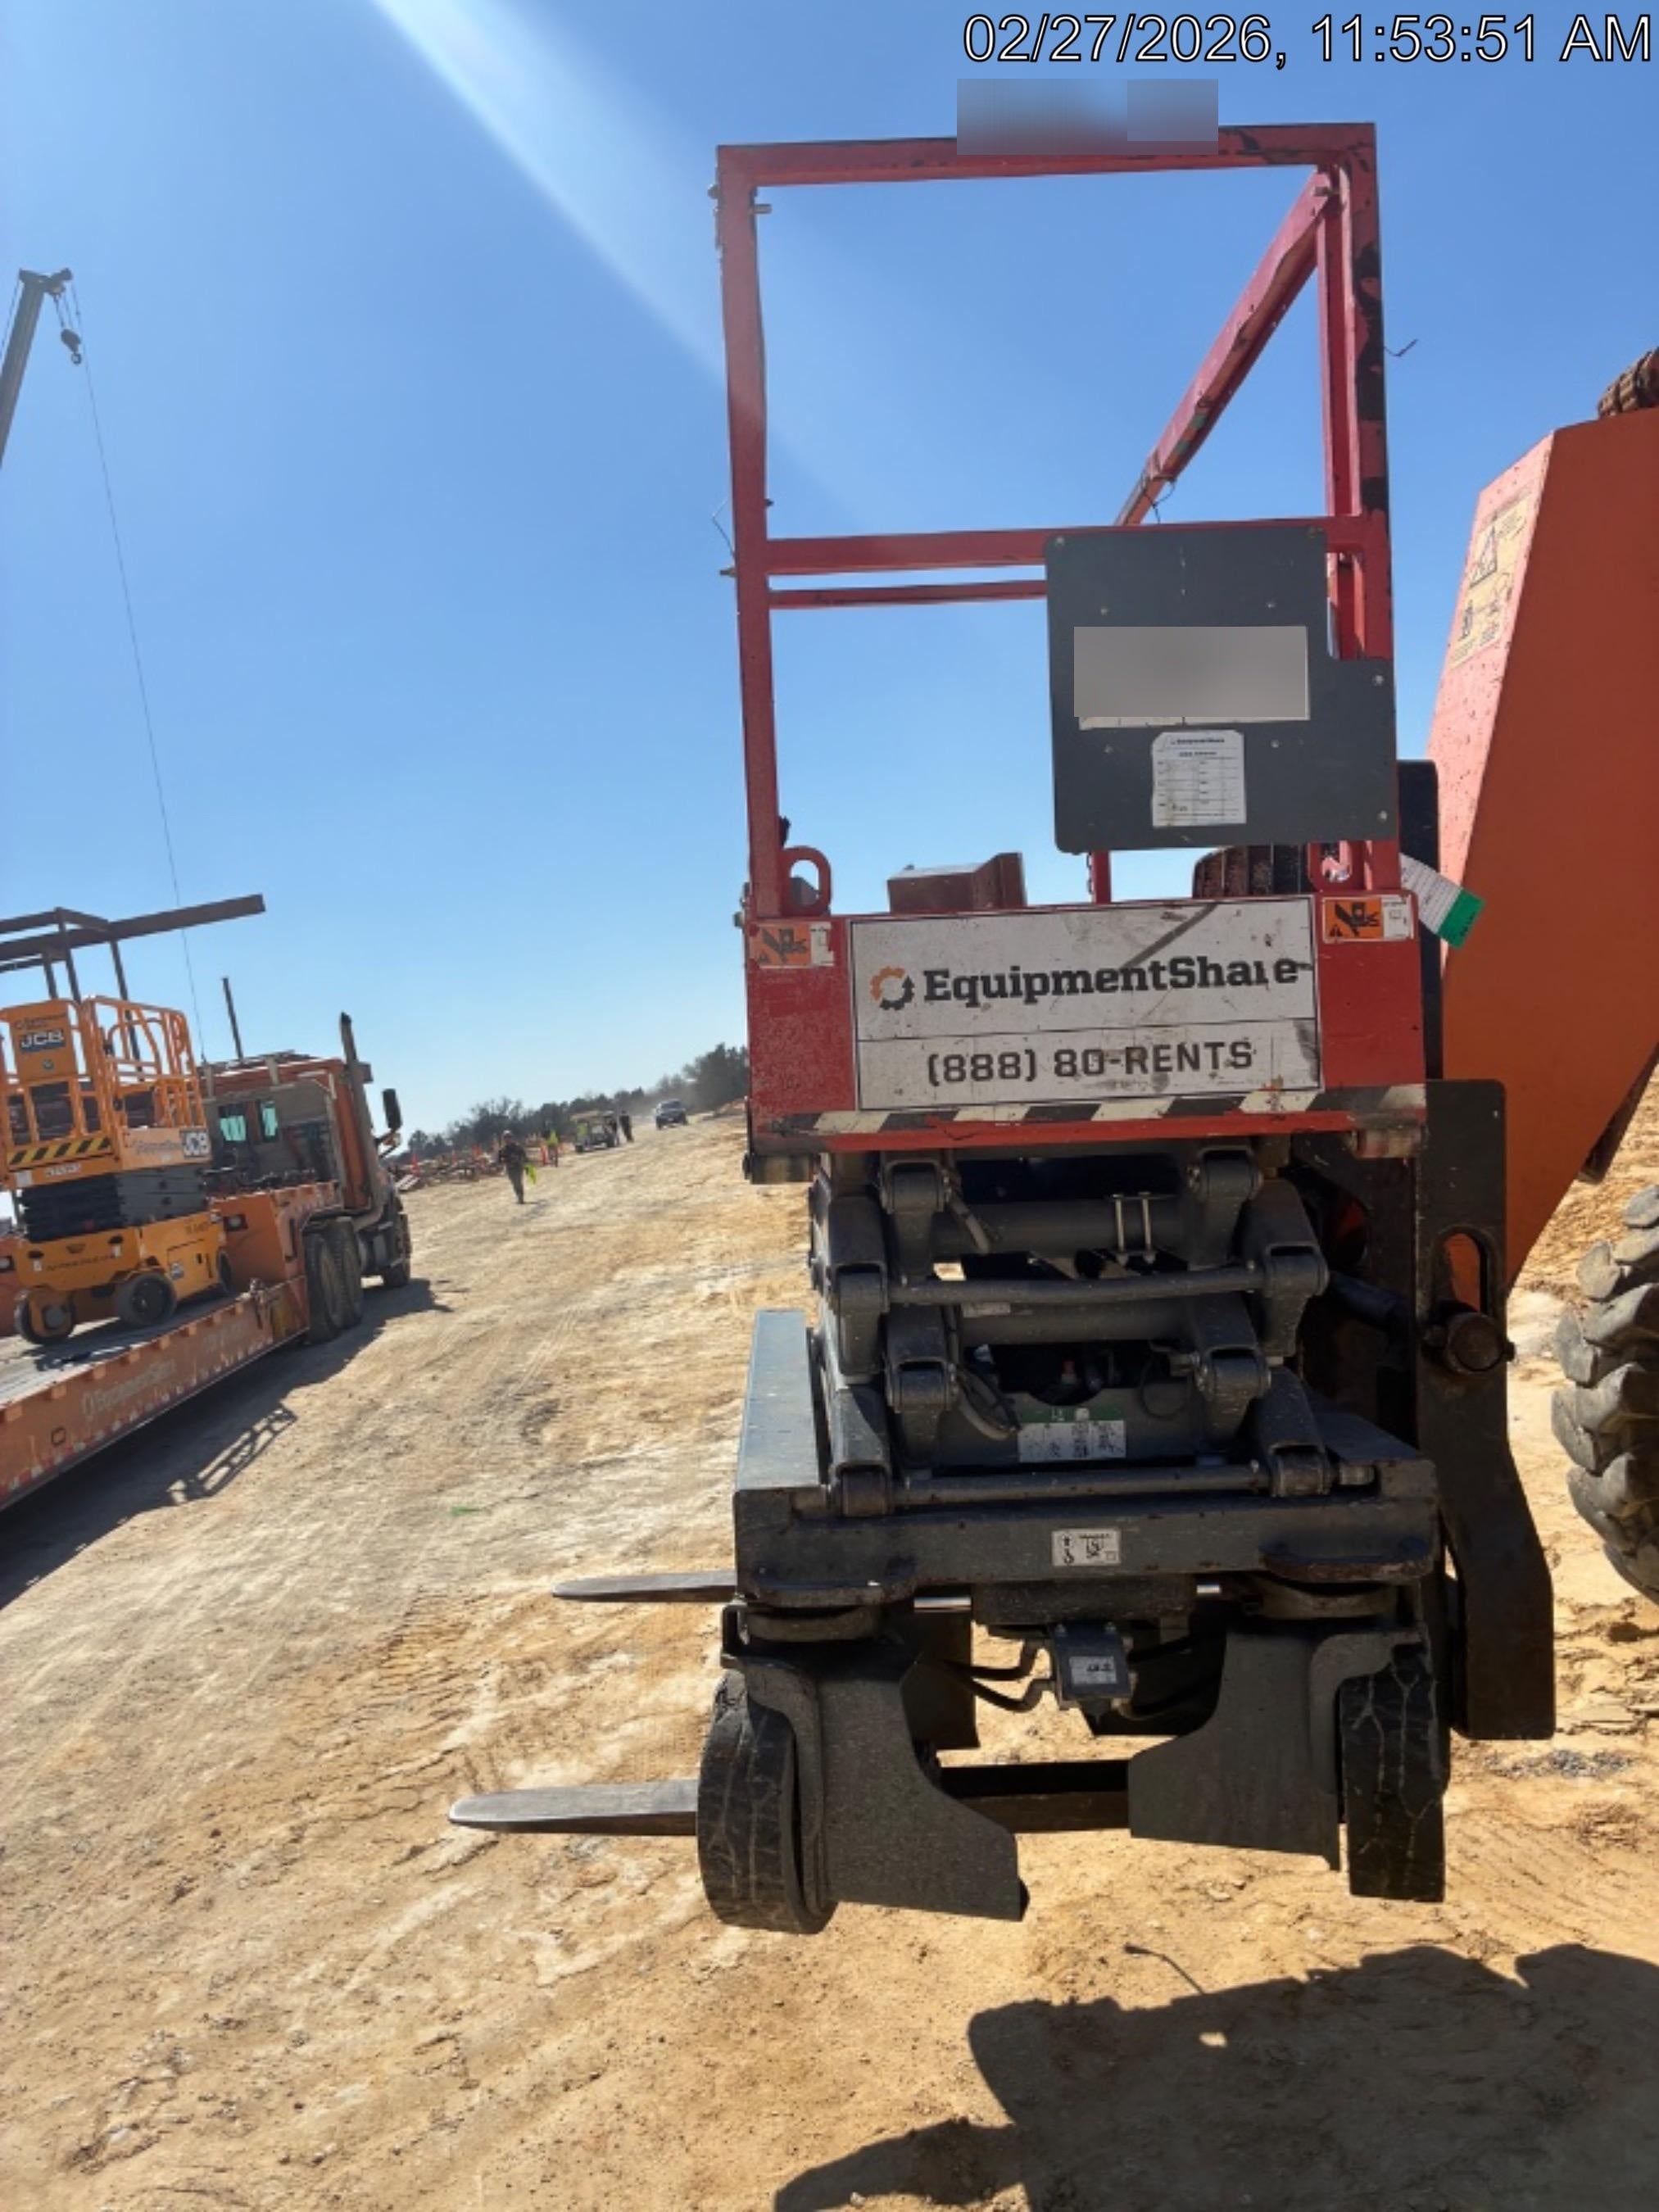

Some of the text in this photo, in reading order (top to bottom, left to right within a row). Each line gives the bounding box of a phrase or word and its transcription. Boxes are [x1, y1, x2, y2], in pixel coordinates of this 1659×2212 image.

[20, 1030, 65, 1049] JCB
[928, 1040, 1253, 1087] (888) 80-RENTS
[184, 1131, 210, 1157] JCB
